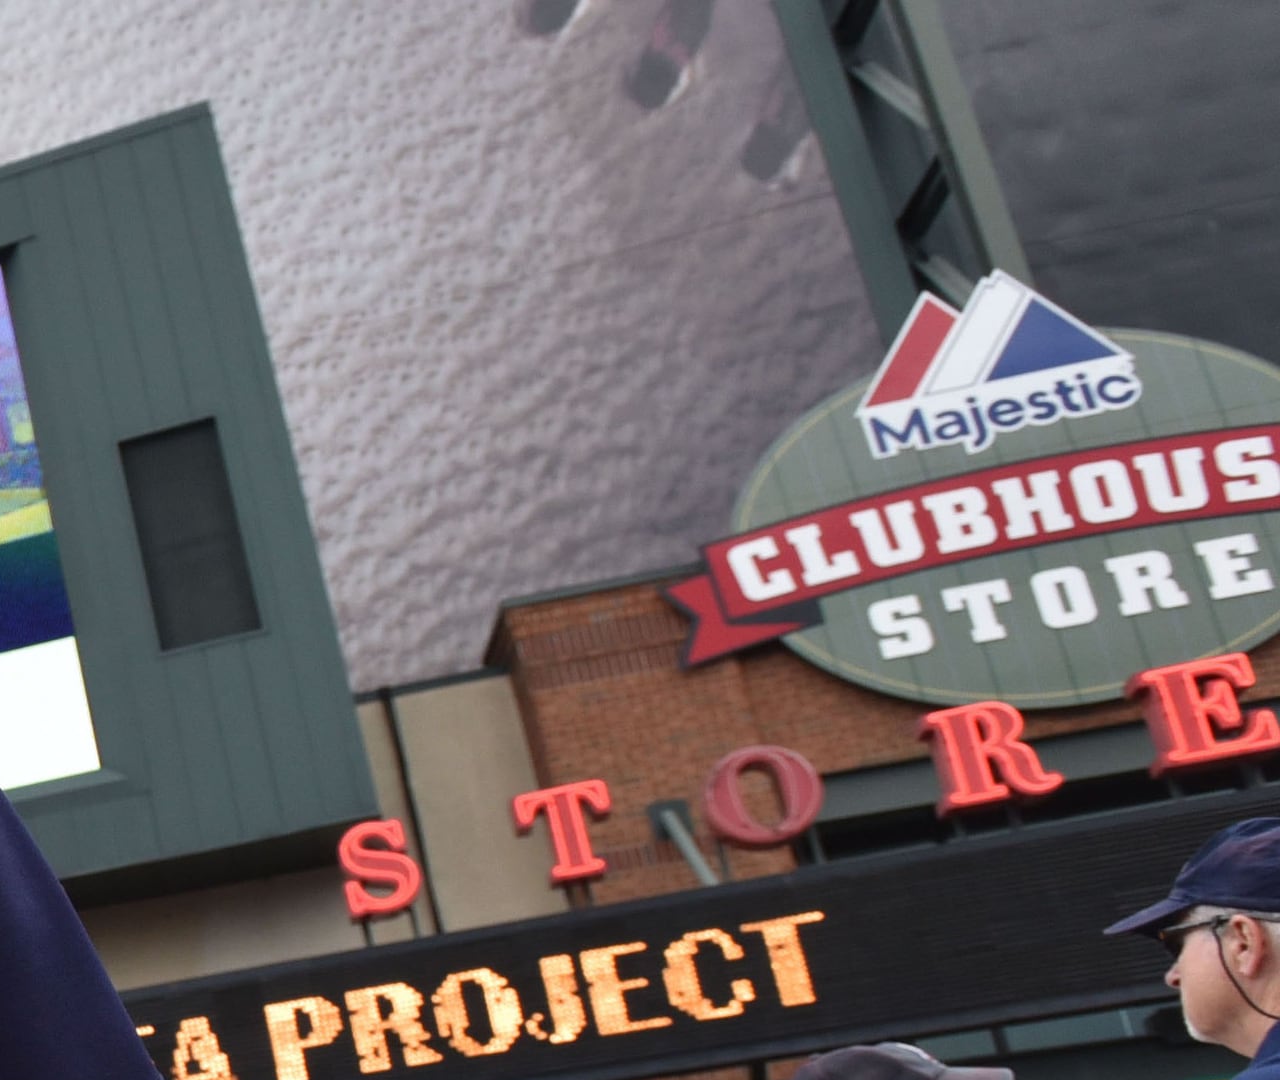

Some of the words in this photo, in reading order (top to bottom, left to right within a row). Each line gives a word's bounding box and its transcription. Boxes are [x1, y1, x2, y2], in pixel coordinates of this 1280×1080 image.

[869, 371, 1138, 454] Majestic
[726, 436, 1280, 602] CLUBHOUS
[867, 533, 1274, 659] STORE
[338, 652, 1280, 919] STORE
